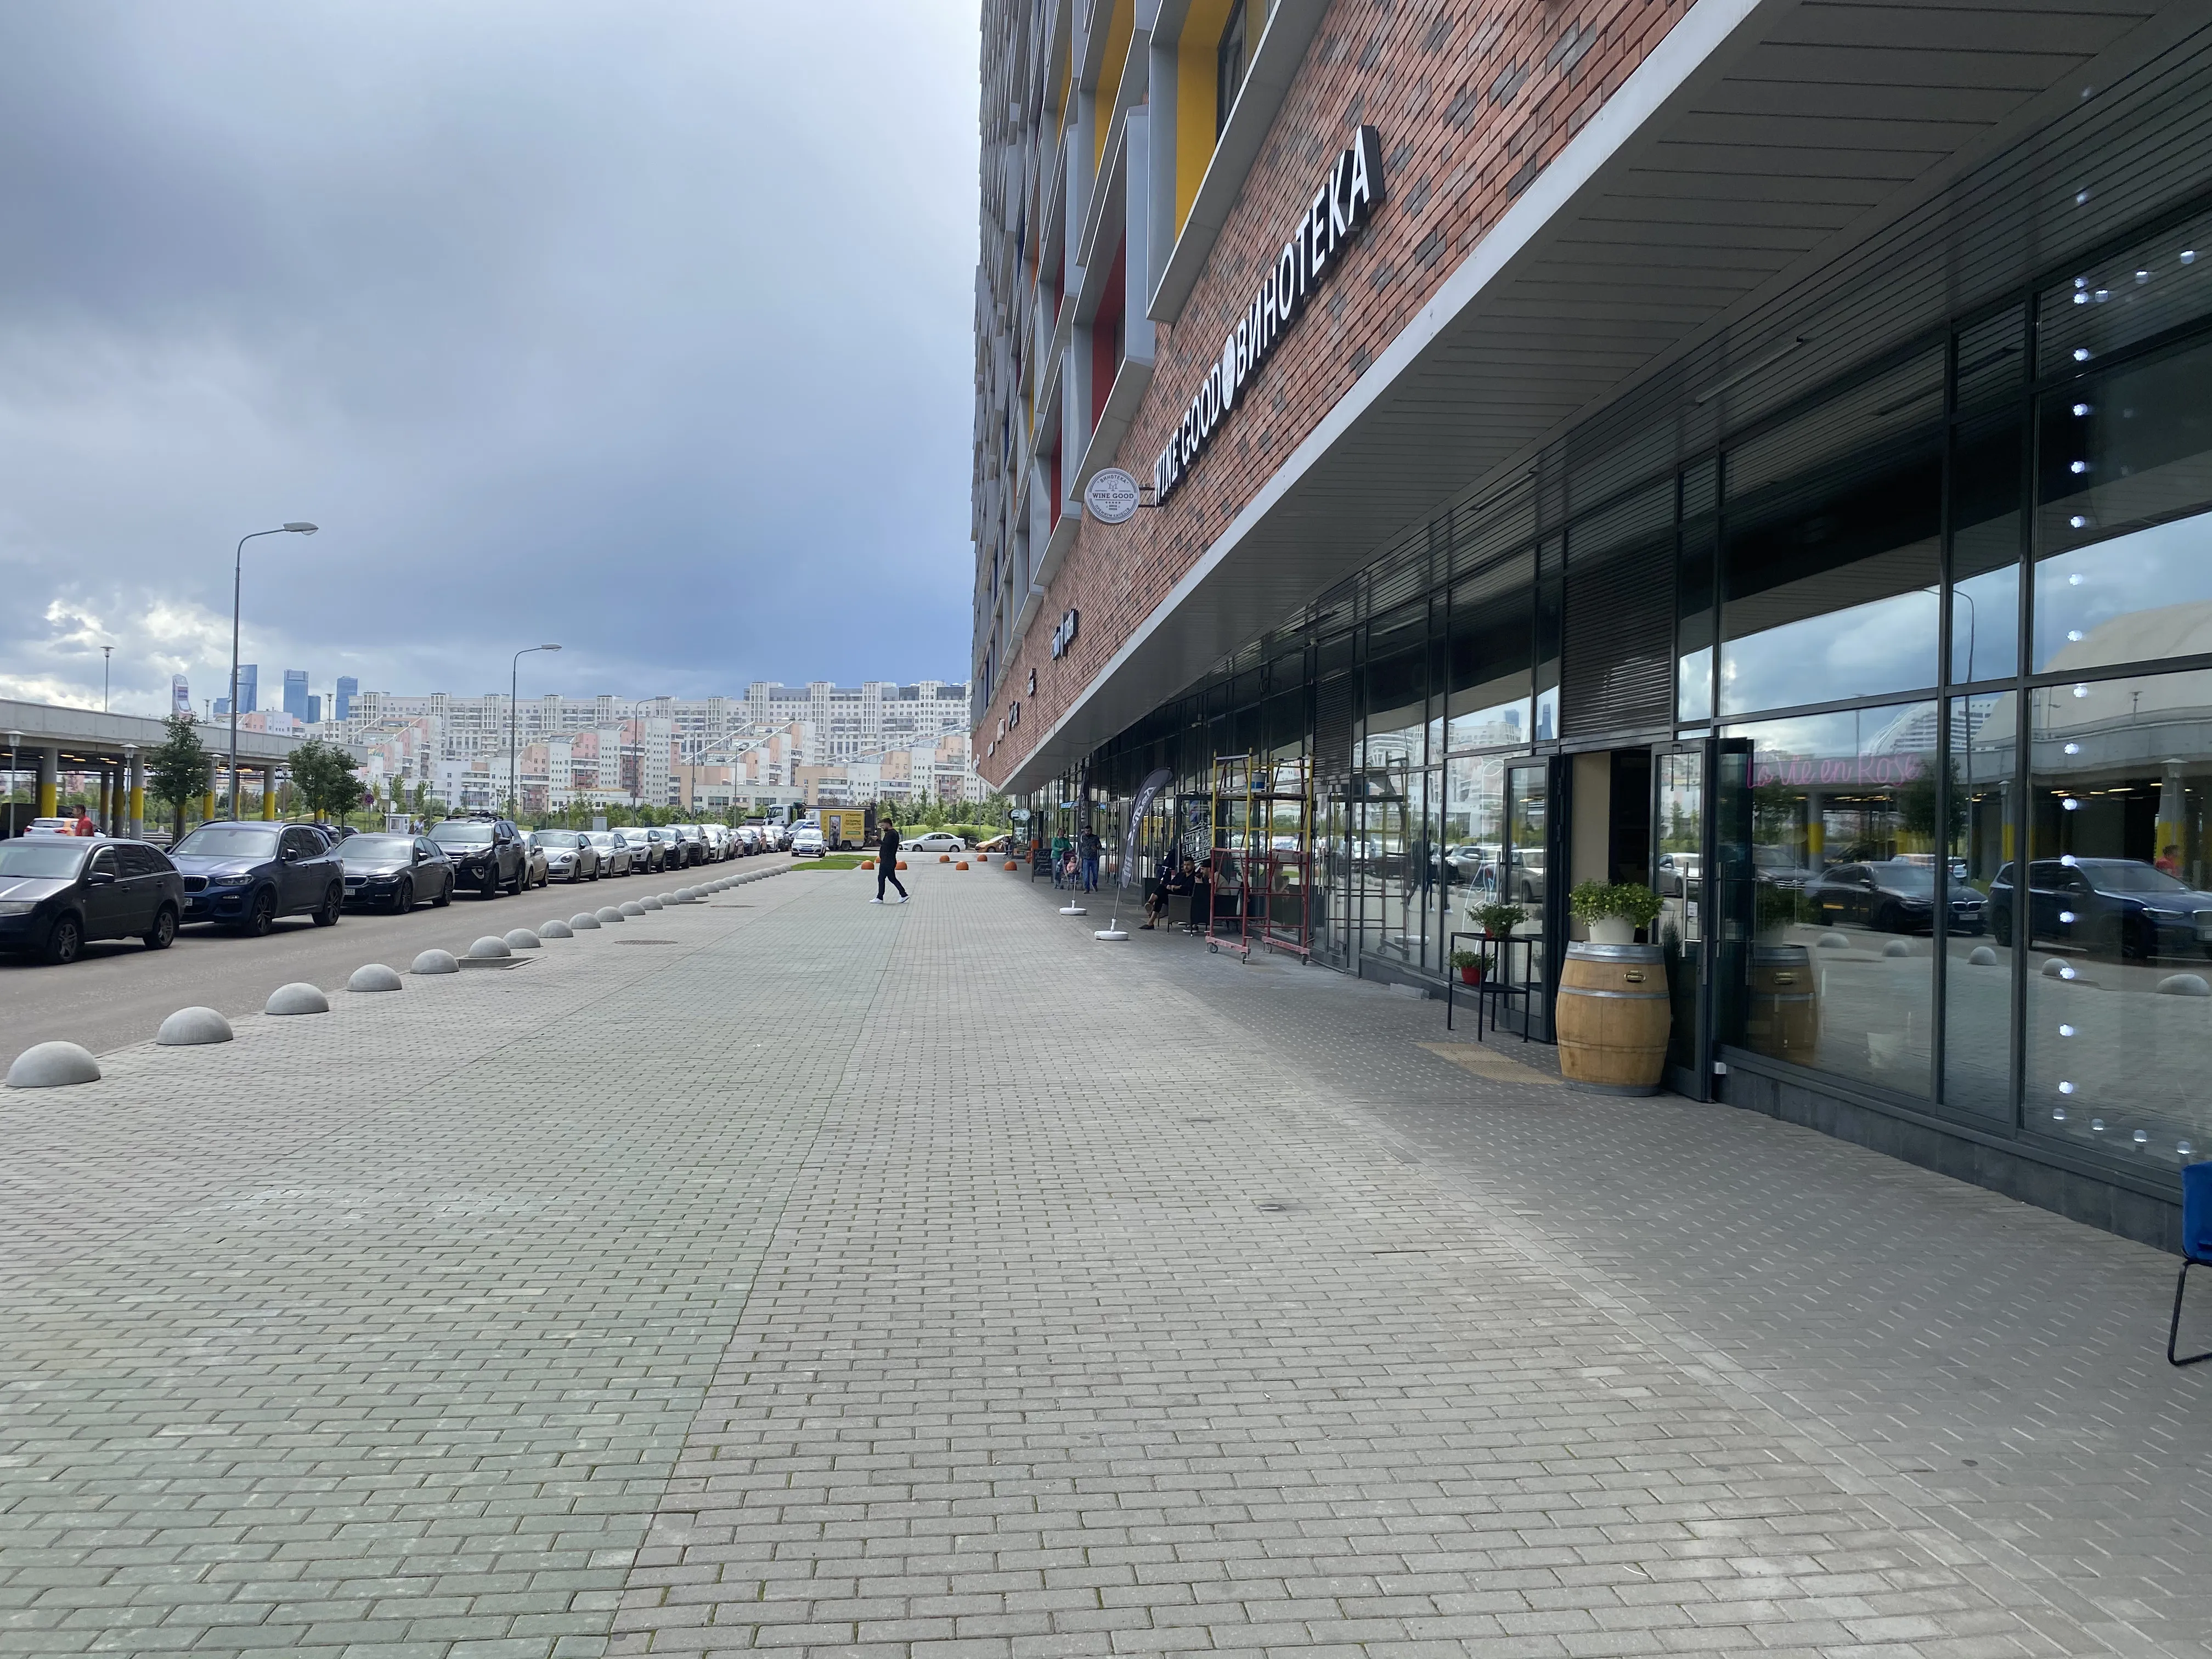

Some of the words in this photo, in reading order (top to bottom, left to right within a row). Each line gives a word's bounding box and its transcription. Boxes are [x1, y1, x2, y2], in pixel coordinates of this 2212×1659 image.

[1154, 428, 1178, 505] WINE
[1182, 363, 1221, 466] GOOD
[1237, 125, 1369, 387] ВИНОТЕКА
[1099, 475, 1126, 483] ВИНОТЕКА
[1094, 505, 1112, 517] ПРЕМИУМ
[1747, 757, 1774, 789] La
[1775, 754, 1817, 785] Vie
[1820, 759, 1853, 783] en
[1858, 750, 1920, 787] Rose
